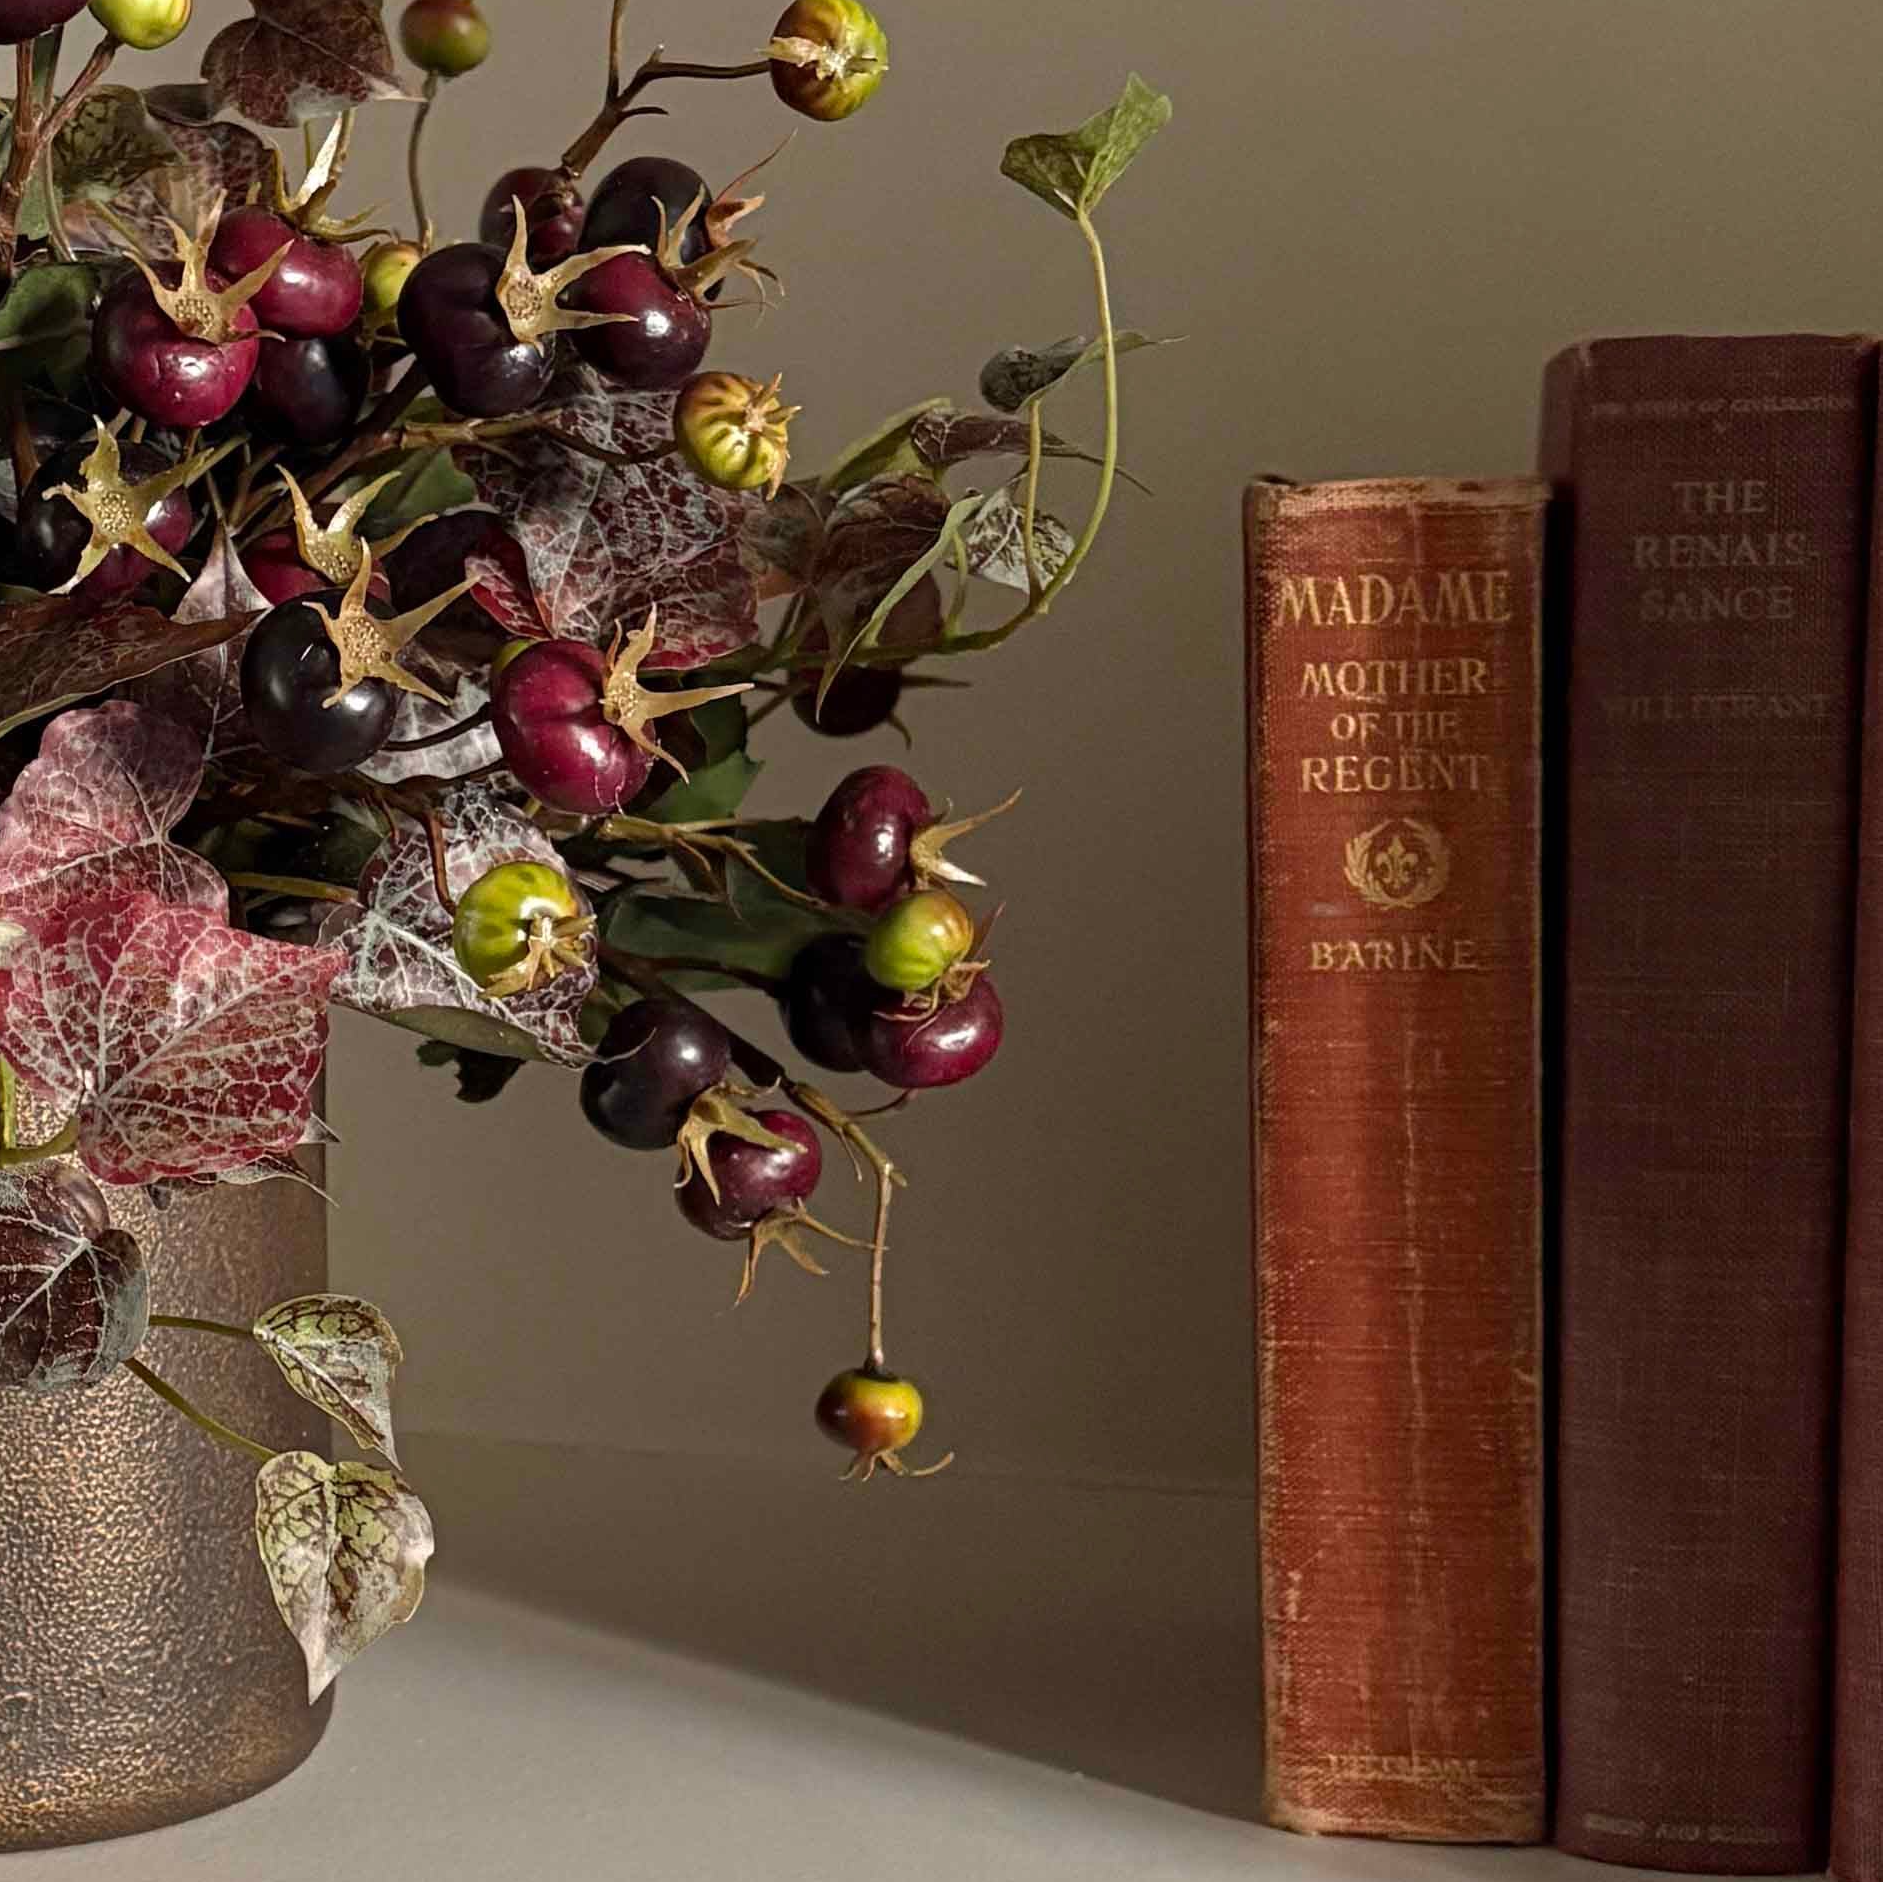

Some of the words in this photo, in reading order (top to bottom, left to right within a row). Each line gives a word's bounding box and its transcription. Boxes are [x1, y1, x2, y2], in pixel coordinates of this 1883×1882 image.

[1672, 479, 1768, 514] THE
[1276, 570, 1511, 626] MADAME
[1638, 585, 1796, 622] SANCE
[1301, 658, 1487, 700] MOTHER
[1330, 713, 1380, 744] OF
[1388, 712, 1460, 740] THE
[1300, 755, 1490, 792] REGENT
[1311, 938, 1478, 970] BARINE
